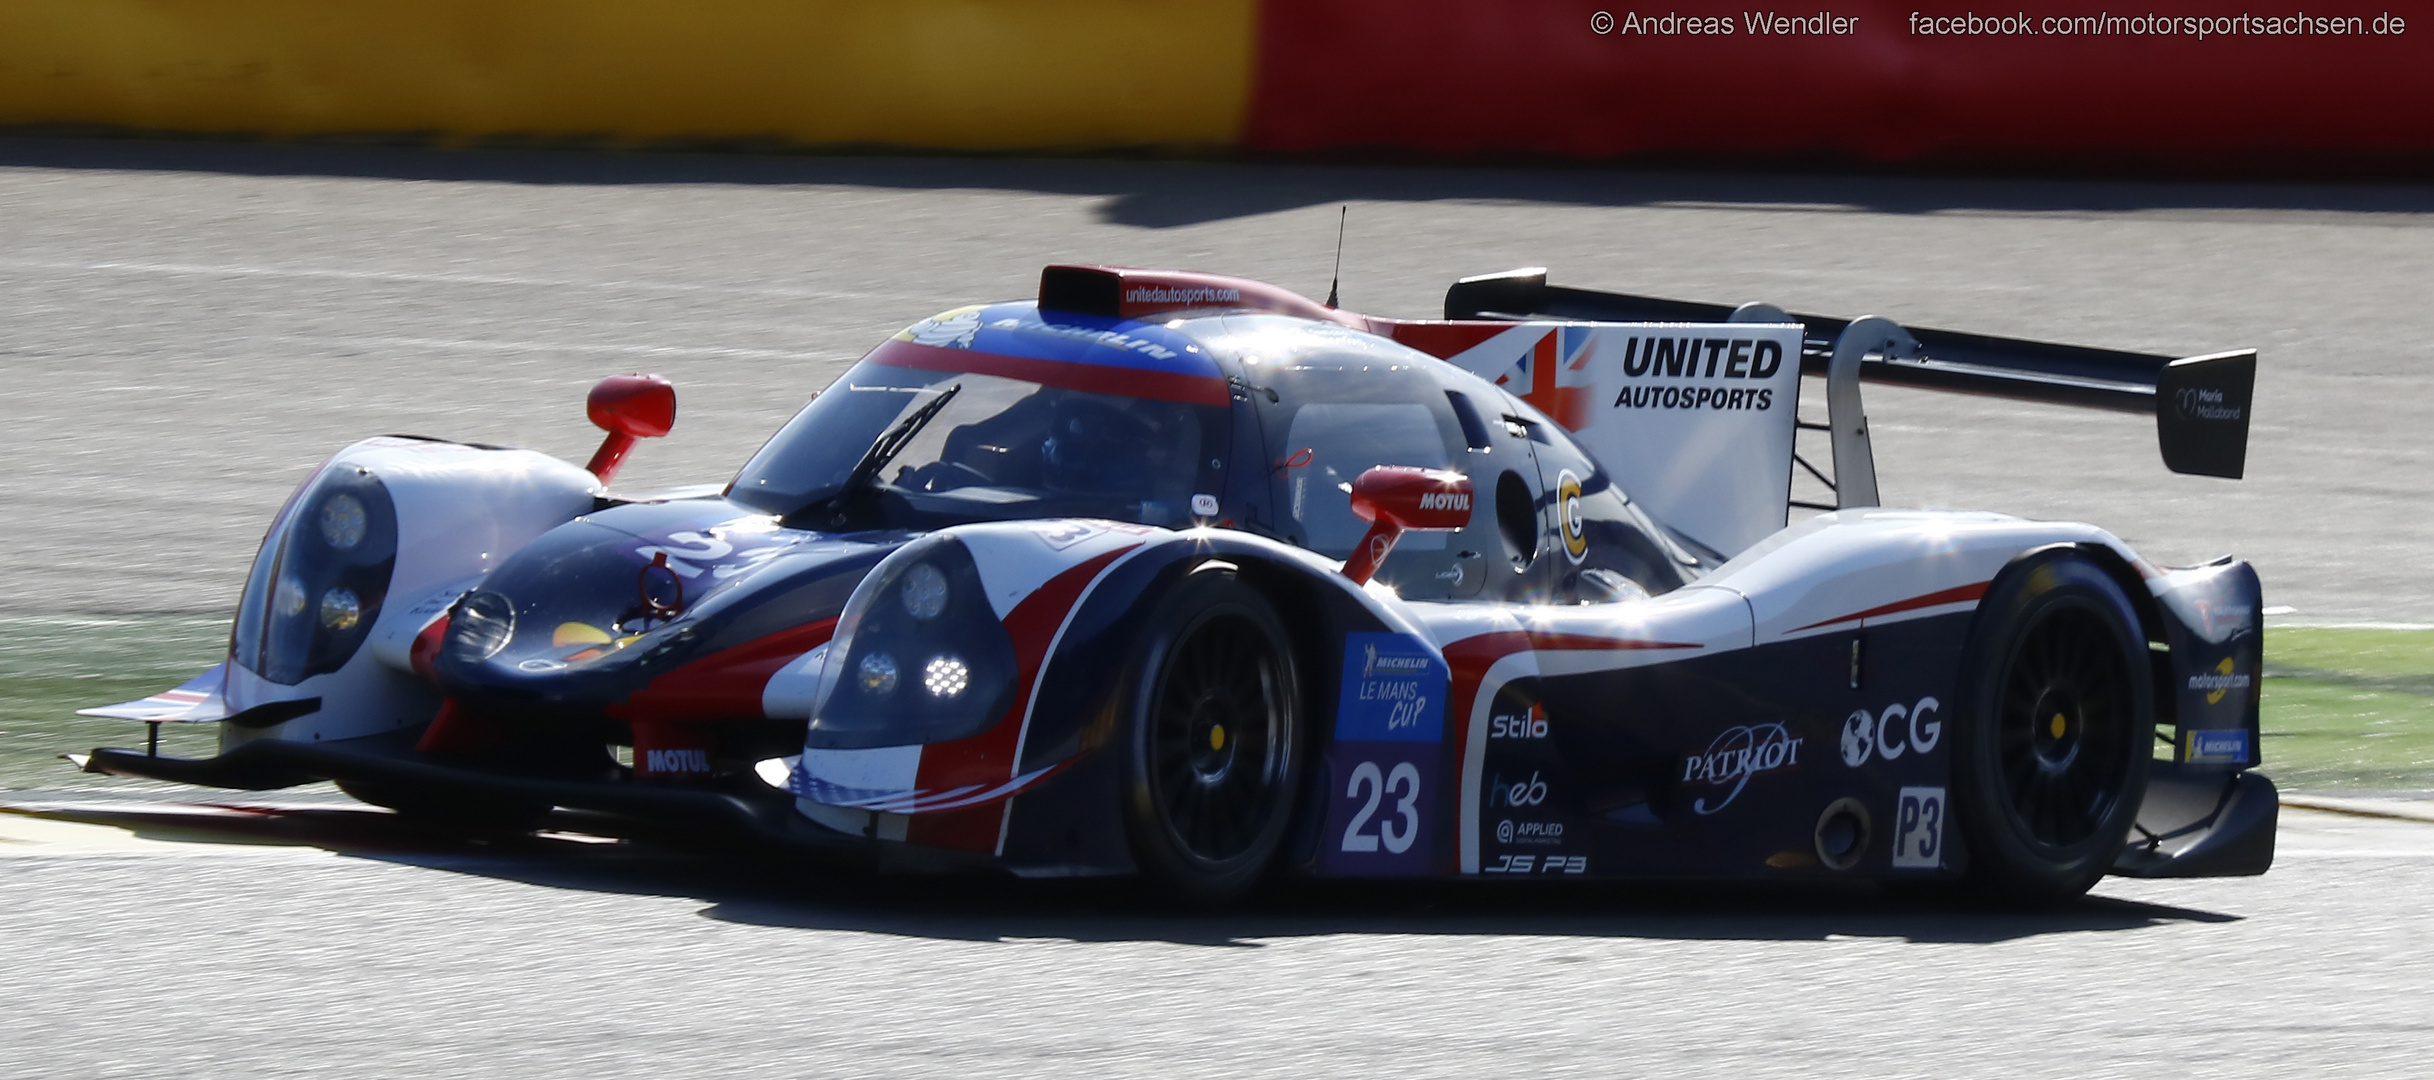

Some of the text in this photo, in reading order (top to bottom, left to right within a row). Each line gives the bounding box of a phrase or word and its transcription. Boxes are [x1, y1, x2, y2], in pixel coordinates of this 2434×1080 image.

[1126, 286, 1240, 306] unitedautosports.com
[1623, 336, 1783, 379] UNITED
[1613, 386, 1773, 411] AUTOSPORTS
[1419, 492, 1471, 511] MOTUL
[1376, 656, 1430, 669] MICHELIN
[1359, 680, 1418, 700] LE MANS
[2188, 671, 2250, 691] motorsport.com
[1388, 696, 1427, 730] CUP
[1491, 706, 1549, 738] Stilo
[647, 749, 710, 773] MOTUL
[1682, 738, 1803, 782] PATRIOT
[1489, 770, 1548, 808] heb
[1341, 760, 1421, 854] 23
[1516, 822, 1564, 836] APPLIED
[1896, 795, 1940, 858] P3
[1484, 855, 1588, 873] JS P3
